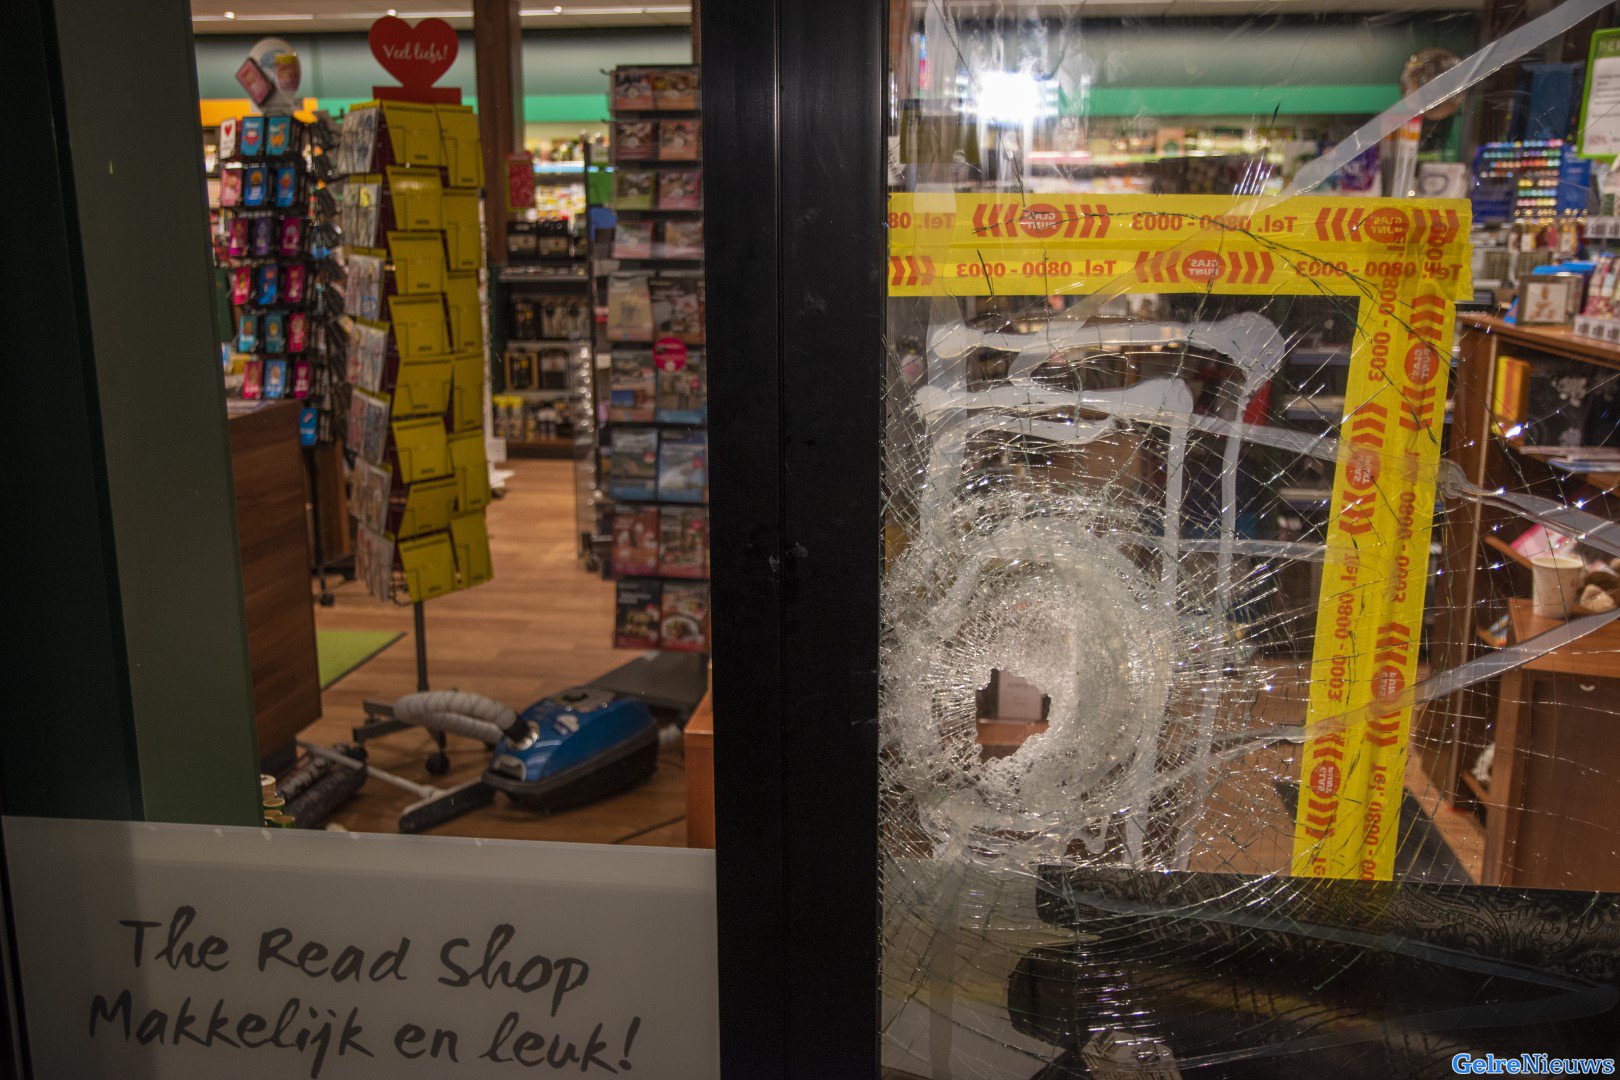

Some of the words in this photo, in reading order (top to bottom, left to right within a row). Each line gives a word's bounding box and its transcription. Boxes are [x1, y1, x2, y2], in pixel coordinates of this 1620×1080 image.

[382, 42, 412, 60] Veel
[119, 905, 230, 973] The
[257, 926, 410, 983] Read
[437, 923, 590, 1017] Shop
[88, 989, 374, 1079] Makkelijk
[393, 1020, 459, 1064] en
[479, 1012, 642, 1074] leuk!
